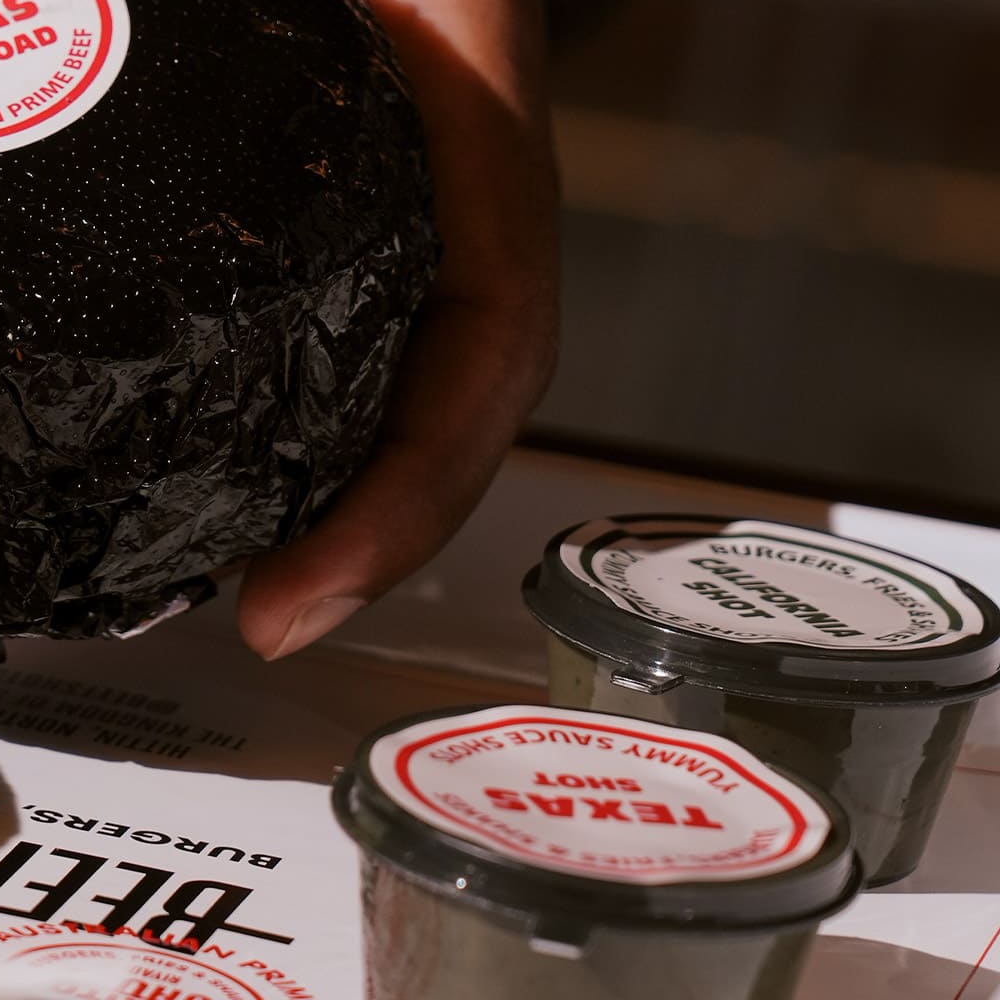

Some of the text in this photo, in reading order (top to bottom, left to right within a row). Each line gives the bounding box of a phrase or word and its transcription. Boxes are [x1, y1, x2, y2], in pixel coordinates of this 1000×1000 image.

[7, 70, 74, 118] PRIME
[63, 28, 92, 71] BEEF
[681, 580, 776, 619] SHOT
[688, 557, 865, 638] CALIFORNIA
[53, 701, 190, 738] KINGDOM
[194, 729, 247, 751] THE
[430, 728, 740, 795] YUMMY SAUCE SHOTS
[532, 770, 643, 793] SHOT
[485, 787, 724, 831] TEXAS
[22, 804, 282, 869] BURGERS,
